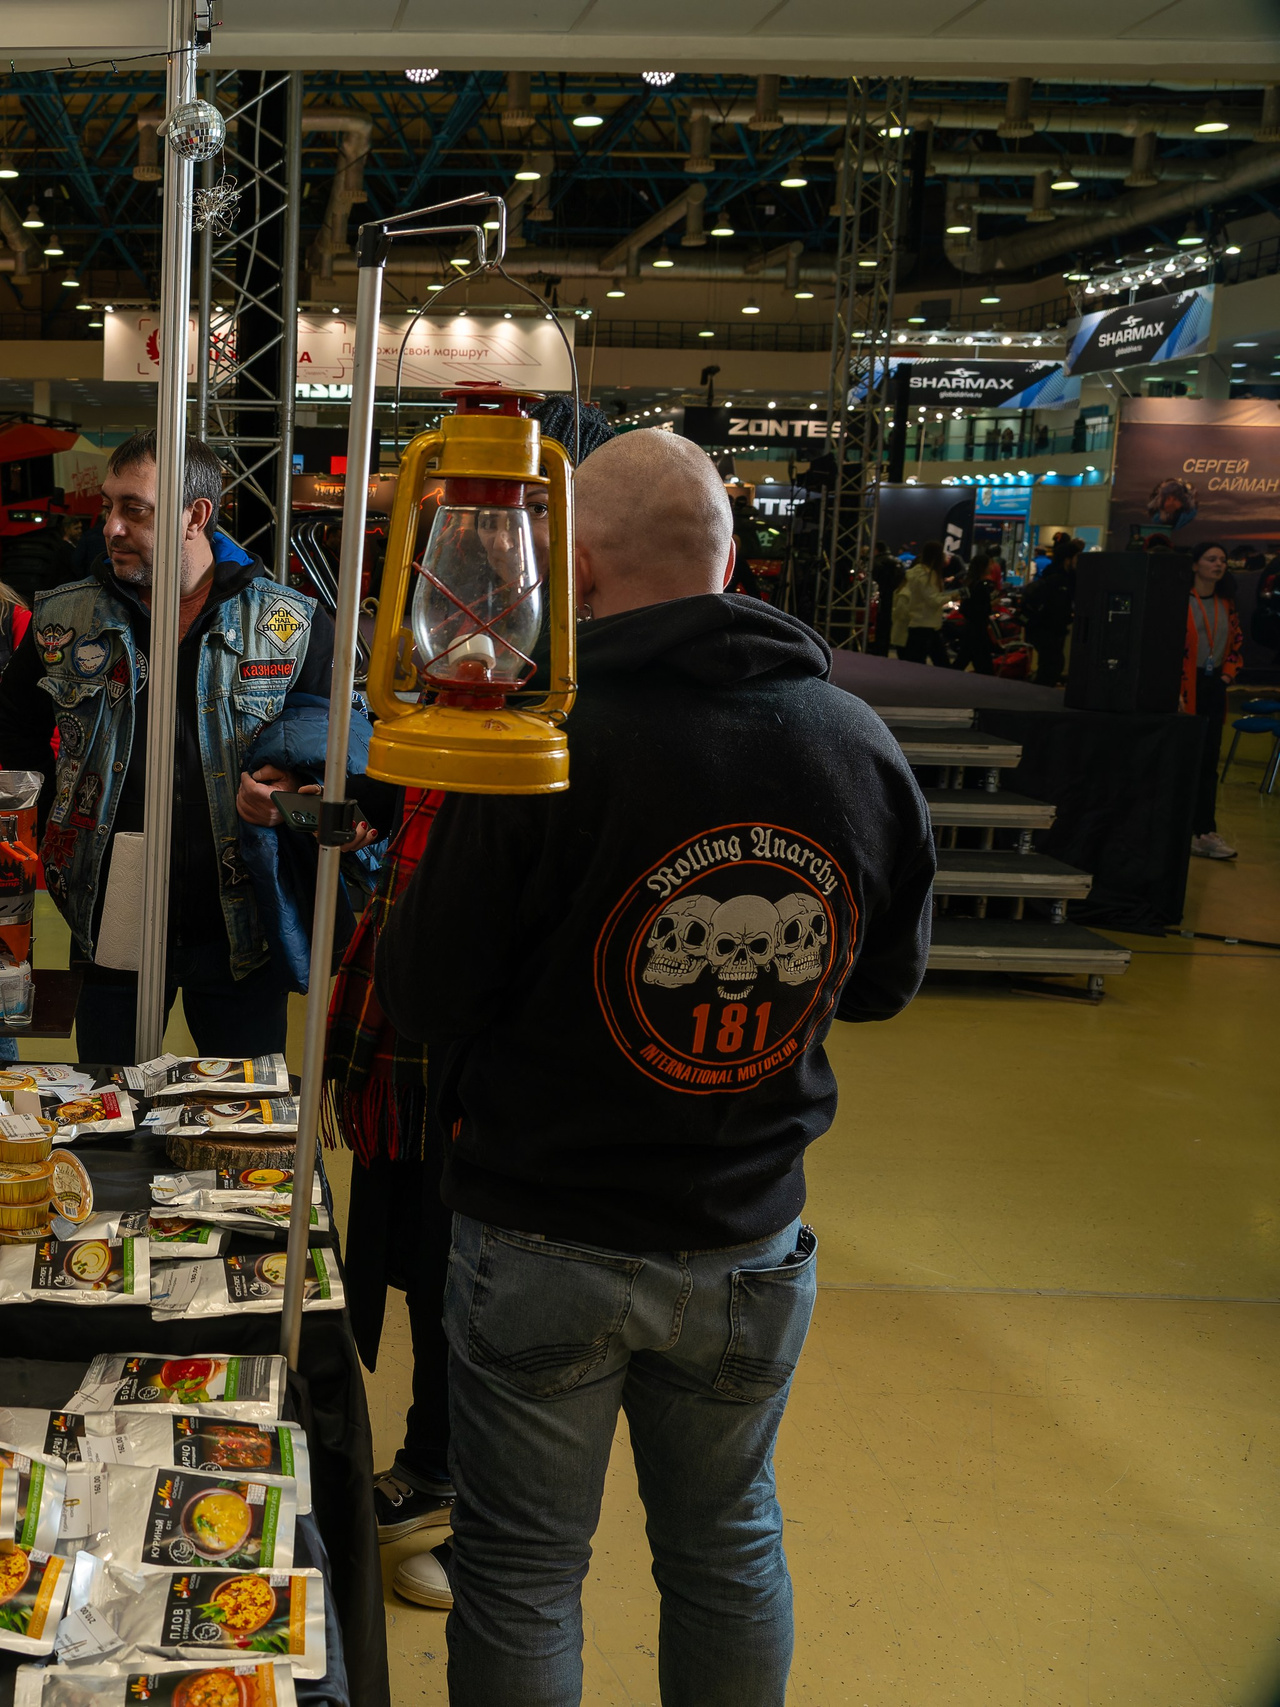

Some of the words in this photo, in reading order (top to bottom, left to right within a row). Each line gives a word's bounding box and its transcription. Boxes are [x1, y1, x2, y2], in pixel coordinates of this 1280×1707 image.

[1098, 321, 1165, 348] SHARMAX
[343, 343, 400, 361] Прожи
[402, 347, 429, 359] свой
[433, 346, 490, 361] маршрут
[909, 376, 1014, 391] SHARMAX
[728, 417, 848, 439] ZONTES
[1183, 458, 1250, 474] СЕРГЕЙ
[1208, 476, 1279, 492] САЙМАН
[270, 609, 293, 619] РОК
[262, 622, 305, 633] ВОЛГОЙ
[647, 835, 742, 898] Rolling
[750, 827, 839, 896] Anarchy
[692, 1002, 772, 1053] 181
[639, 1043, 733, 1085] INTERNATIONAL
[737, 1038, 799, 1082] MOTOCLUB
[124, 1214, 136, 1239] ОЛЯНКА
[150, 1519, 164, 1558] КУРИНЫЙ
[80, 1604, 96, 1625] 210,00
[170, 1608, 184, 1640] ПЛОВ
